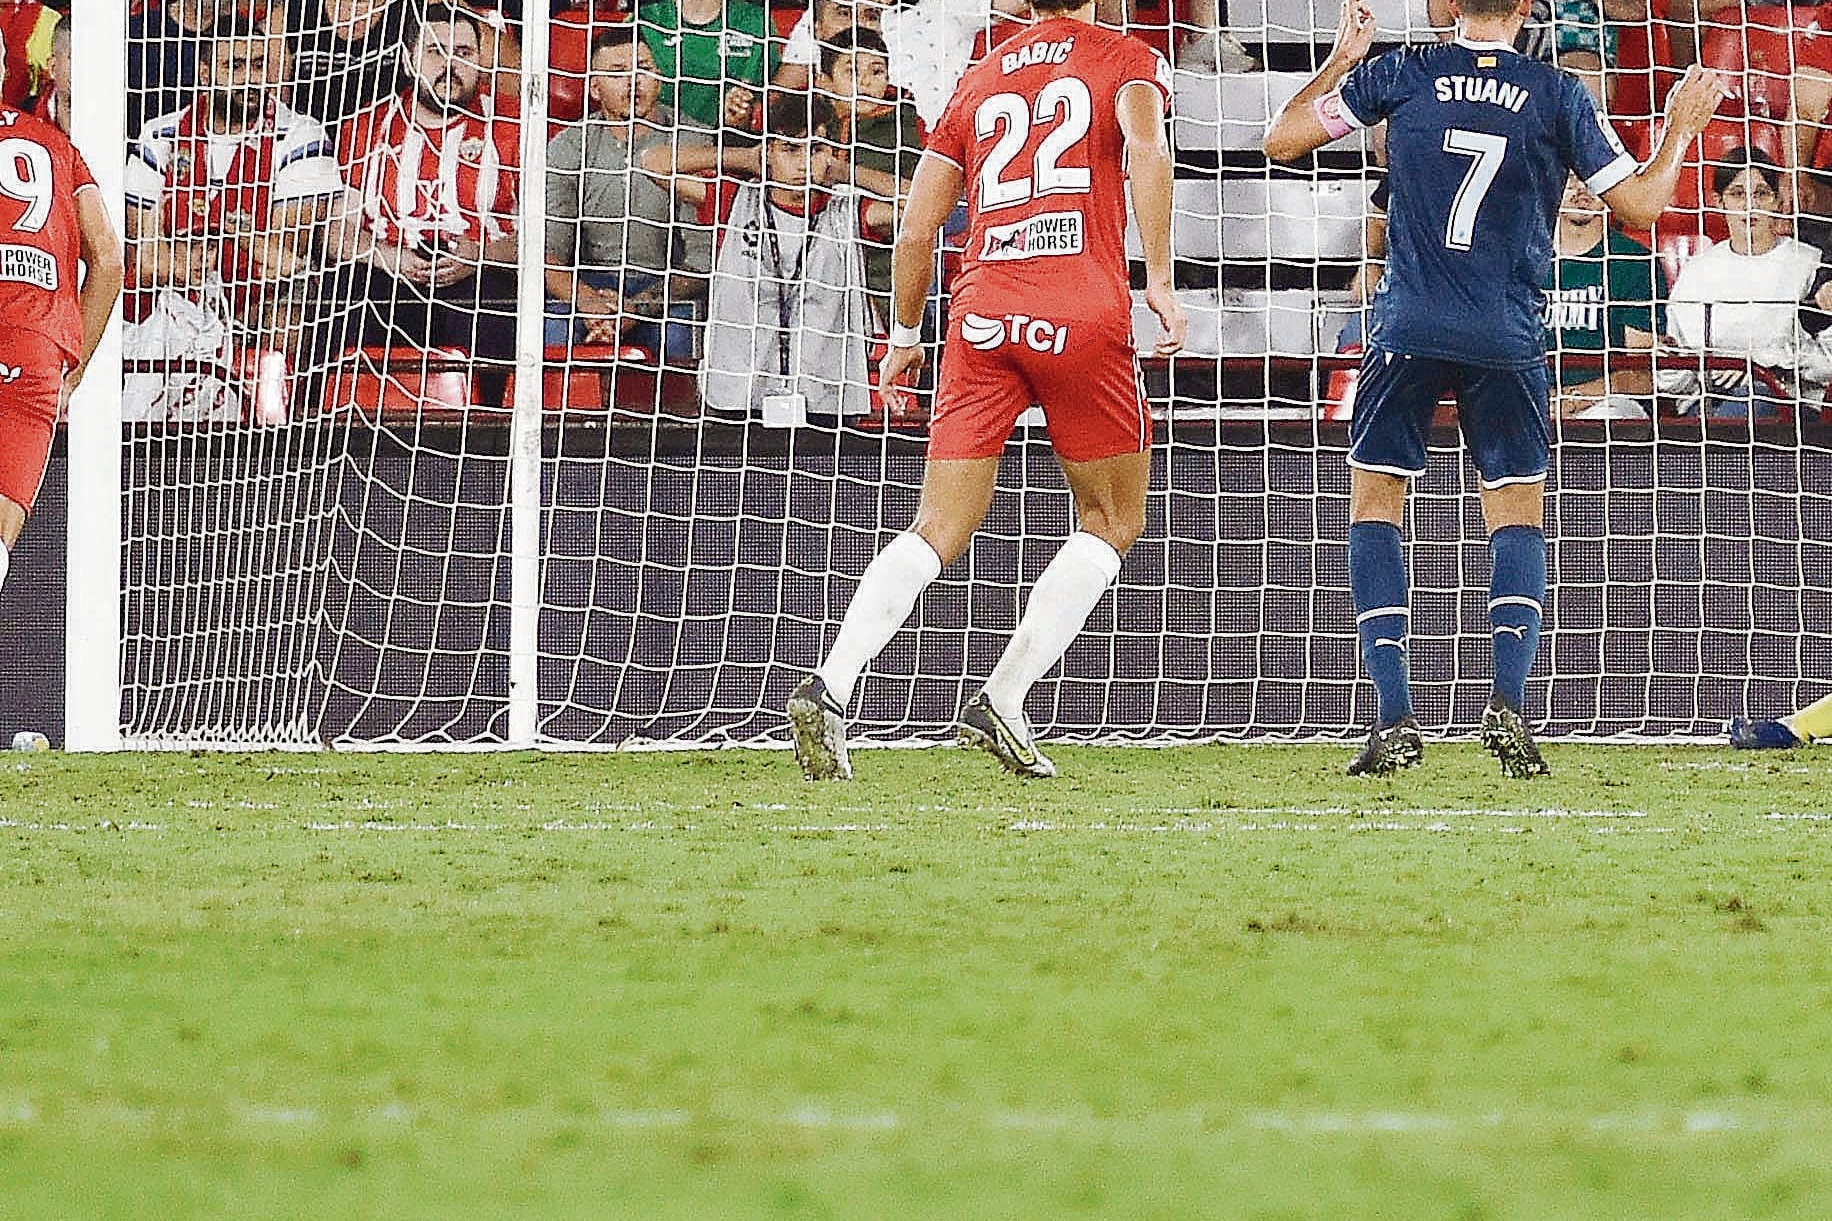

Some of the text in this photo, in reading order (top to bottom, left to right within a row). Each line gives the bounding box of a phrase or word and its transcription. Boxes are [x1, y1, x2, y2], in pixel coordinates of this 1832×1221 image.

[1001, 36, 1075, 75] BABIĆ
[1434, 74, 1530, 114] STUANI
[973, 76, 1092, 213] 22
[1441, 127, 1509, 252] 7
[1027, 233, 1079, 251] HORSE
[1028, 216, 1078, 237] POWER
[5, 248, 51, 271] POWER
[5, 263, 53, 286] HORSE
[1004, 314, 1069, 355] TCI
